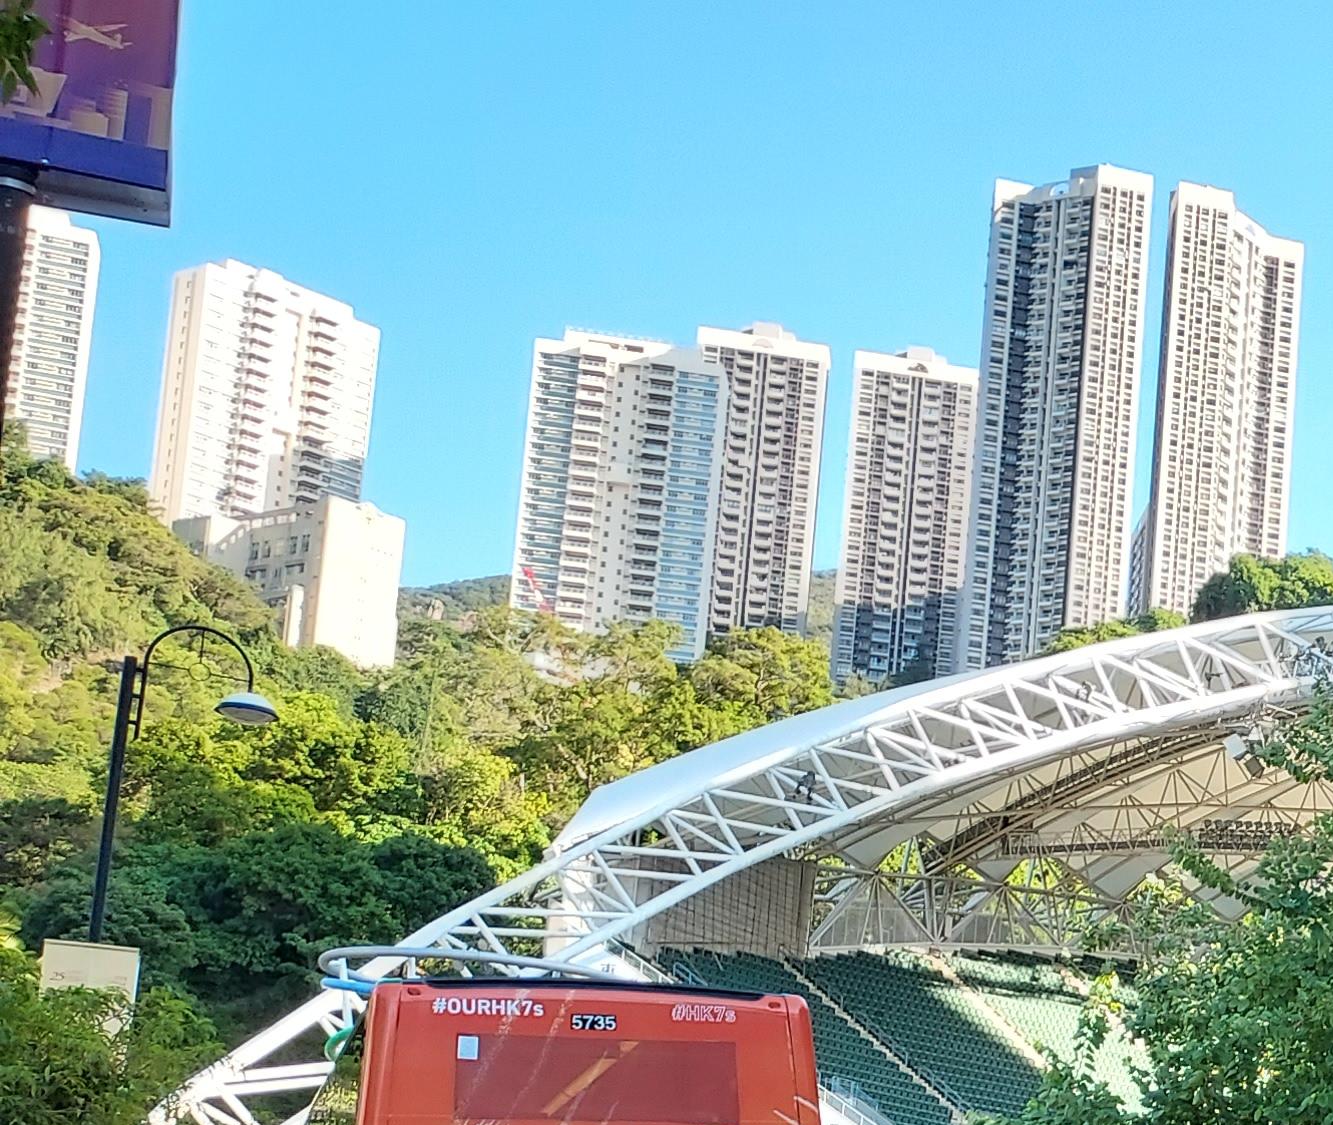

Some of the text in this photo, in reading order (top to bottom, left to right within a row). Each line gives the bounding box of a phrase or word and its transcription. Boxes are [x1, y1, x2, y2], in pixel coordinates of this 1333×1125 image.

[431, 998, 545, 1018] #OURHK7s
[671, 1003, 737, 1024] #HK7s
[571, 1014, 617, 1031] 5735
